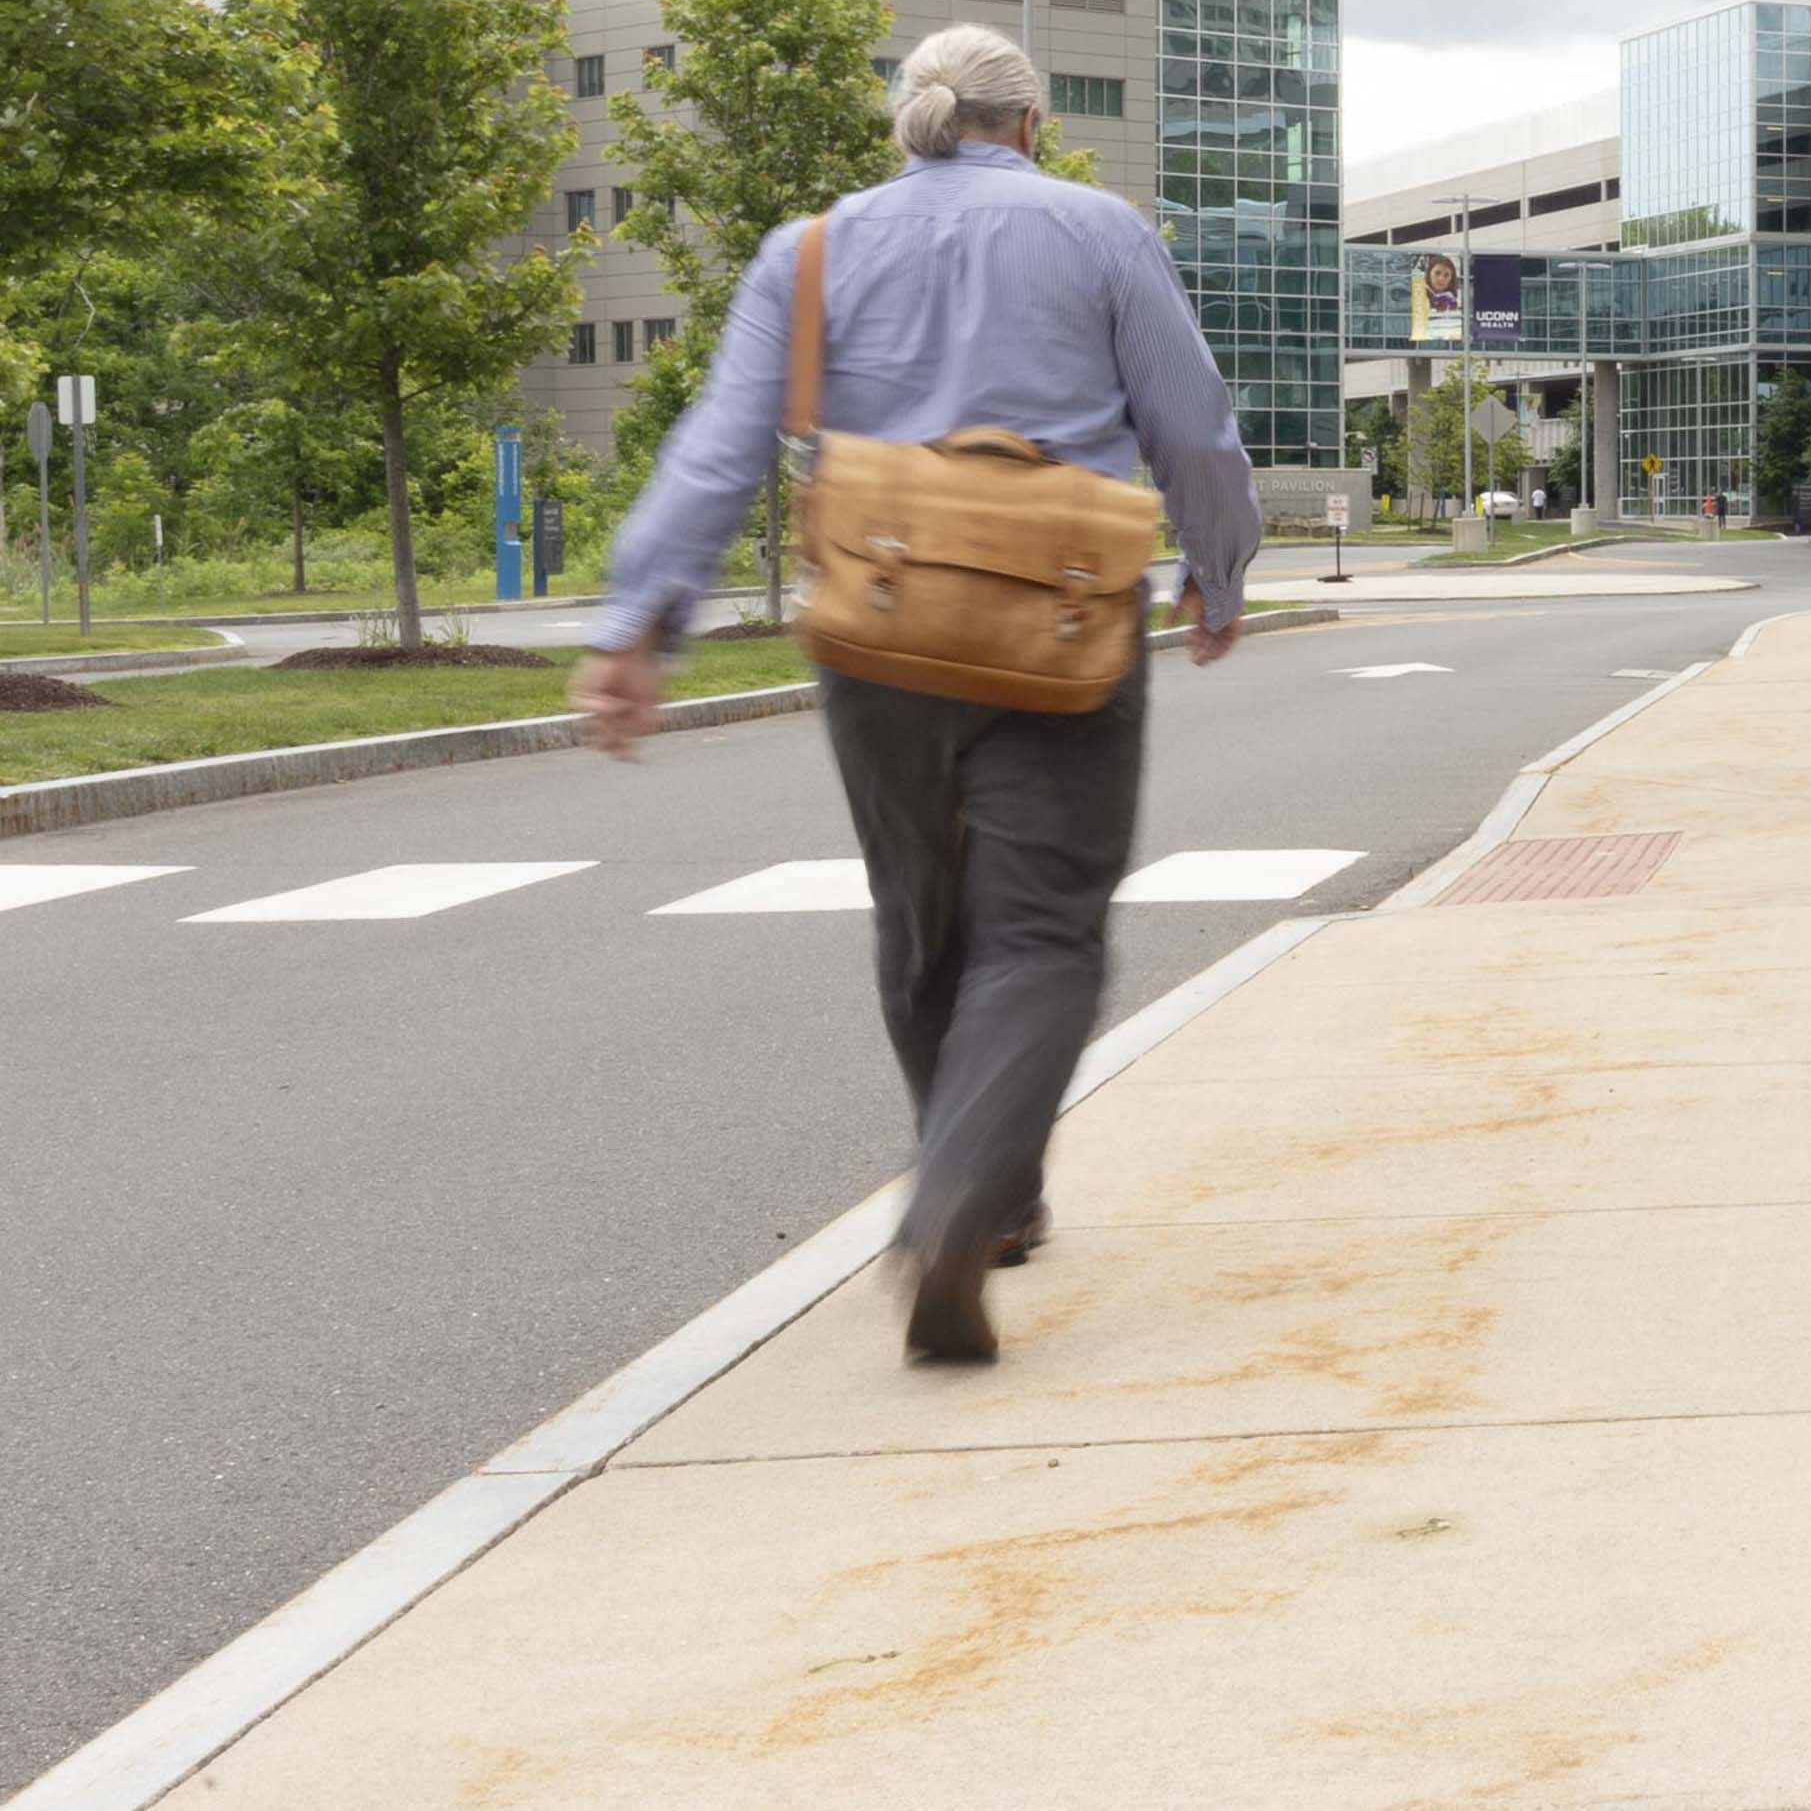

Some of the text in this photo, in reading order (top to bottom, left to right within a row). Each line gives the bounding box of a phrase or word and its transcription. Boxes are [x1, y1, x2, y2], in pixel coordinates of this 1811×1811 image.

[1476, 311, 1519, 322] UCONN
[1480, 321, 1514, 329] HEALTH
[1271, 478, 1336, 493] PAVILION
